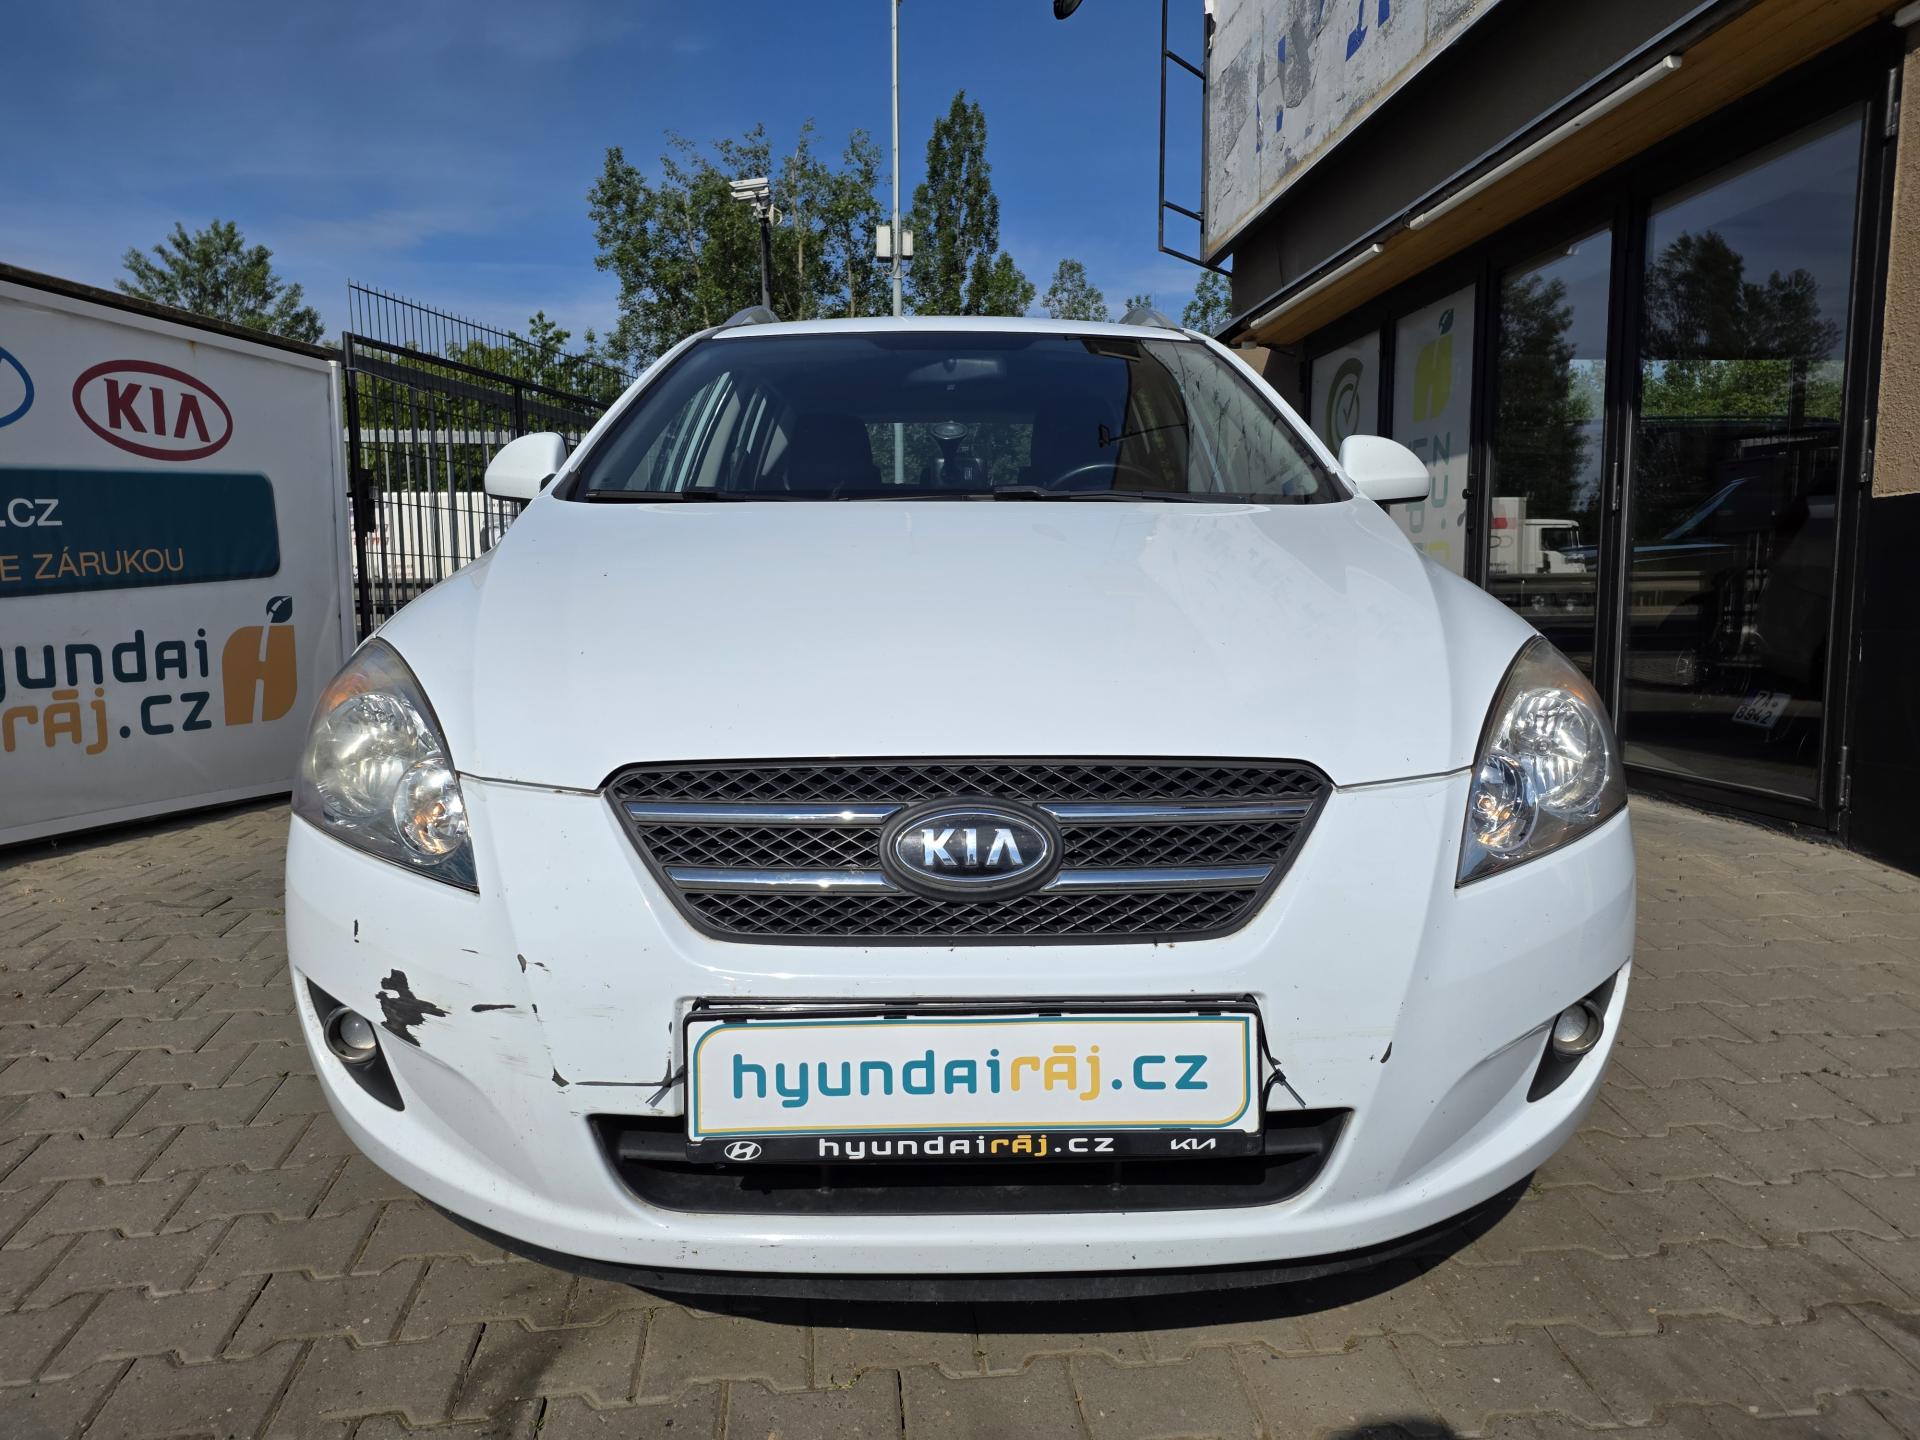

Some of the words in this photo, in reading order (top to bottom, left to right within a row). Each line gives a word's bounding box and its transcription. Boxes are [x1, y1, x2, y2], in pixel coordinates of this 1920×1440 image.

[103, 378, 212, 443] KIA
[32, 546, 184, 580] ZÁRUKOU
[0, 628, 210, 703] undai
[921, 829, 1024, 866] KIA
